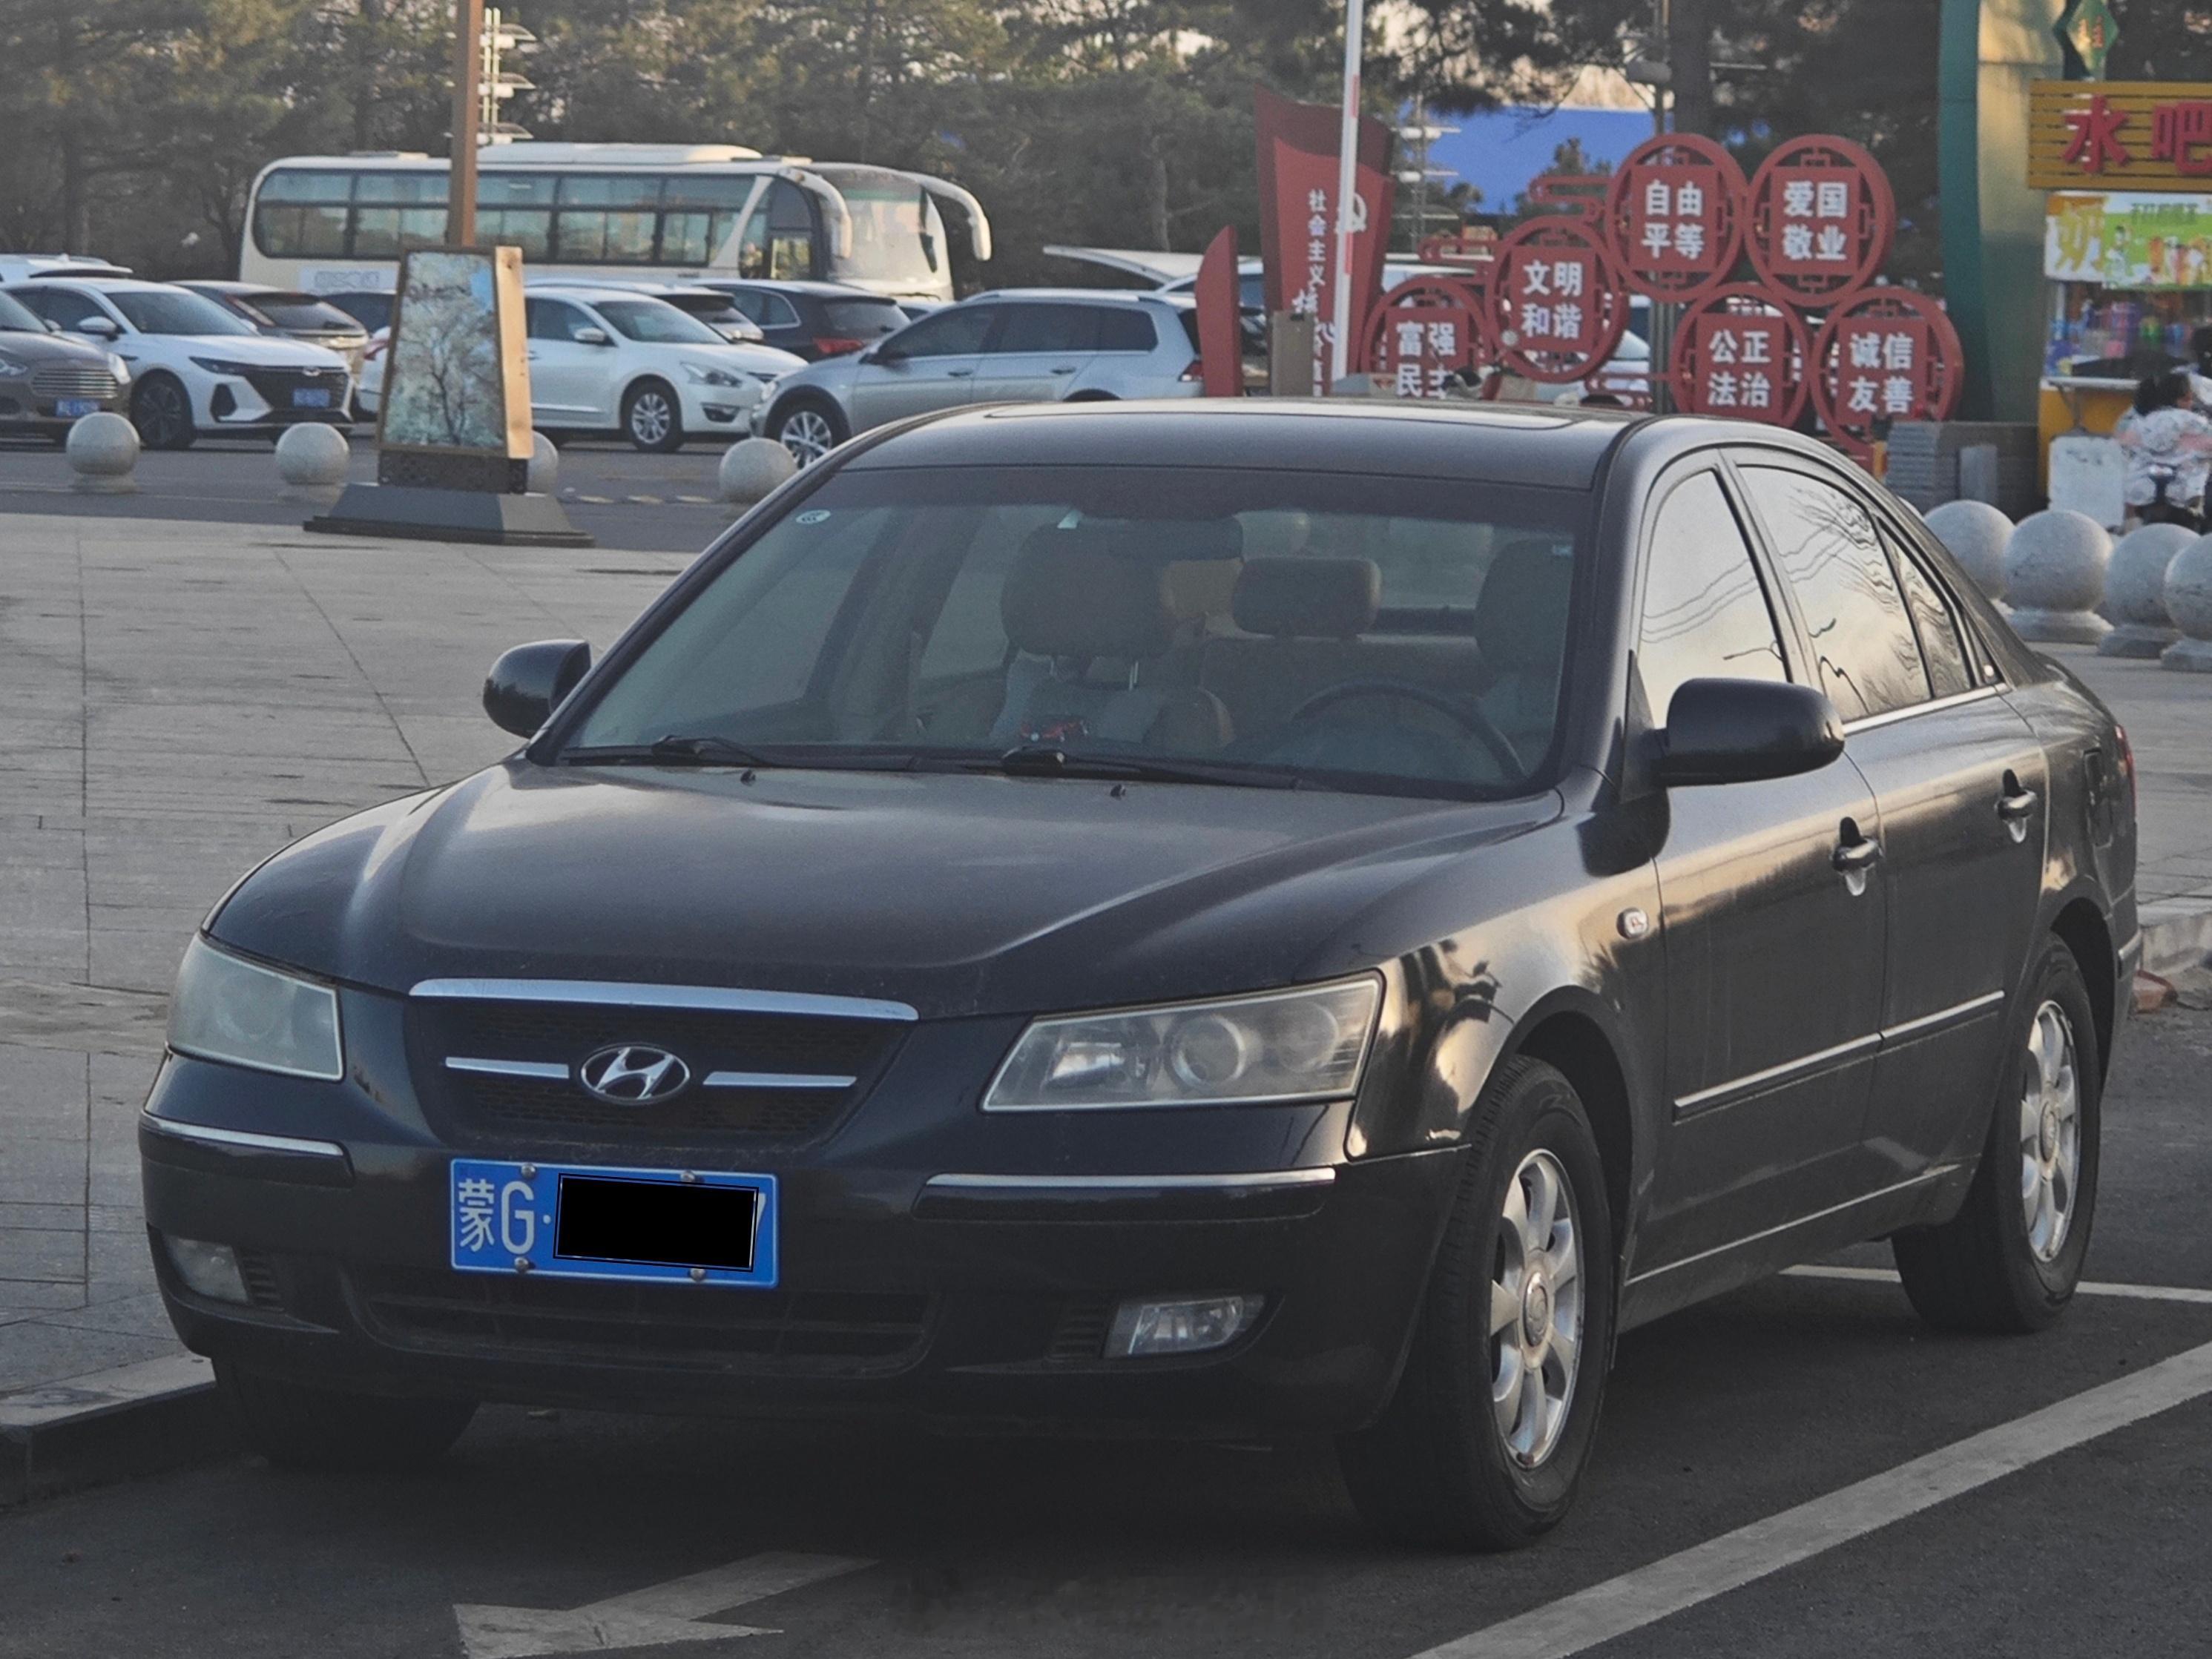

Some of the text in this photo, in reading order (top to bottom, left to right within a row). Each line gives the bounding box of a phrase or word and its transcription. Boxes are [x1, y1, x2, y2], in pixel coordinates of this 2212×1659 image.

[2063, 93, 2212, 174] 水吧
[1645, 179, 1703, 217] 自由
[1784, 180, 1848, 218] 爱国
[1642, 222, 1704, 260] 平等
[1783, 224, 1847, 260] 敬业
[1523, 260, 1583, 297] 文明
[1396, 320, 1456, 357] 富强
[1521, 302, 1583, 340] 和谐
[1709, 329, 1771, 364] 公正
[1850, 332, 1914, 371] 诚信
[1708, 372, 1771, 409] 法治
[1849, 375, 1914, 414] 友善
